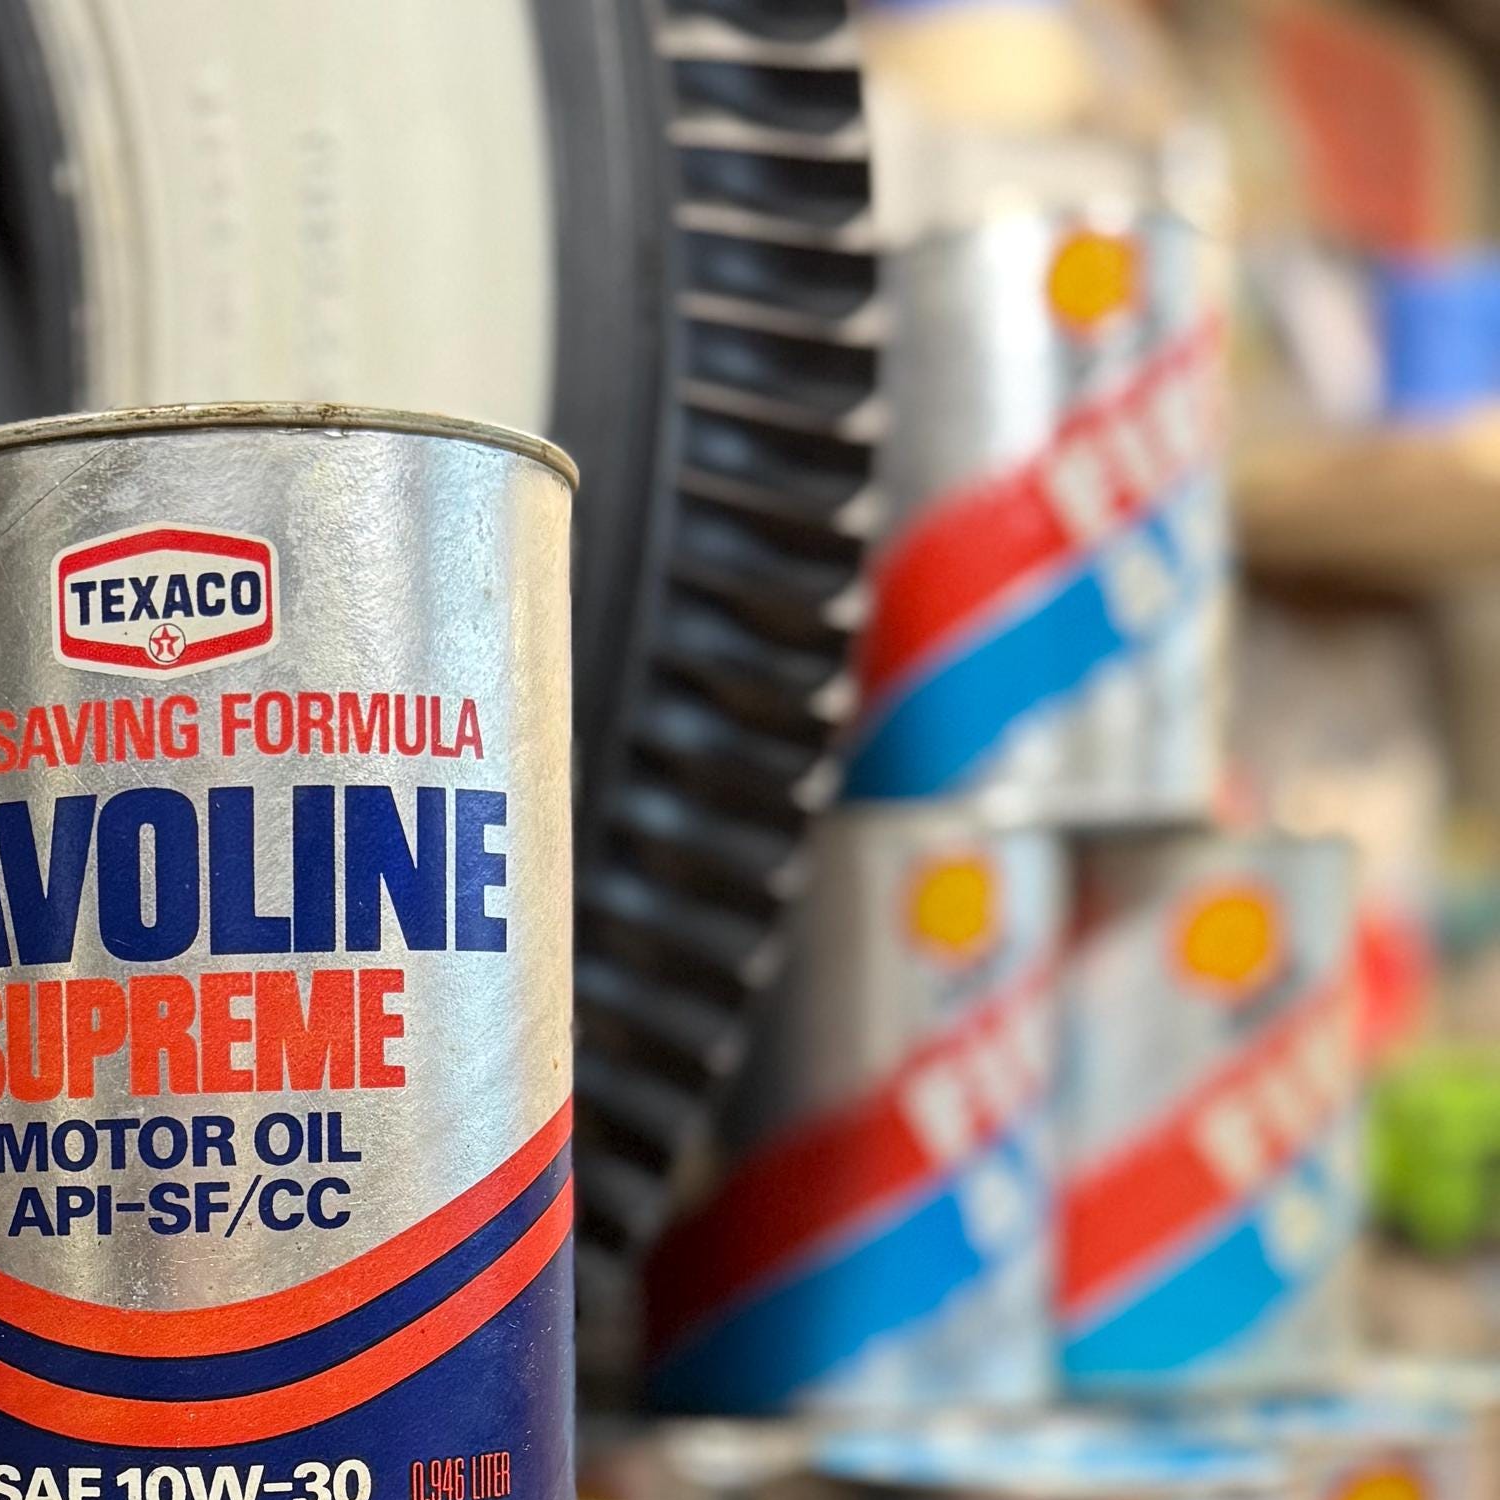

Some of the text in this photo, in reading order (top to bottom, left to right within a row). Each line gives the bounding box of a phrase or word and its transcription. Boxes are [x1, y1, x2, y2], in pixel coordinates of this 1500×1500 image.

[70, 571, 262, 625] TEXACO
[222, 690, 485, 760] FORMULA
[253, 1112, 361, 1165] OIL
[7, 1175, 352, 1238] API-SF/CC
[471, 1452, 511, 1498] LITER
